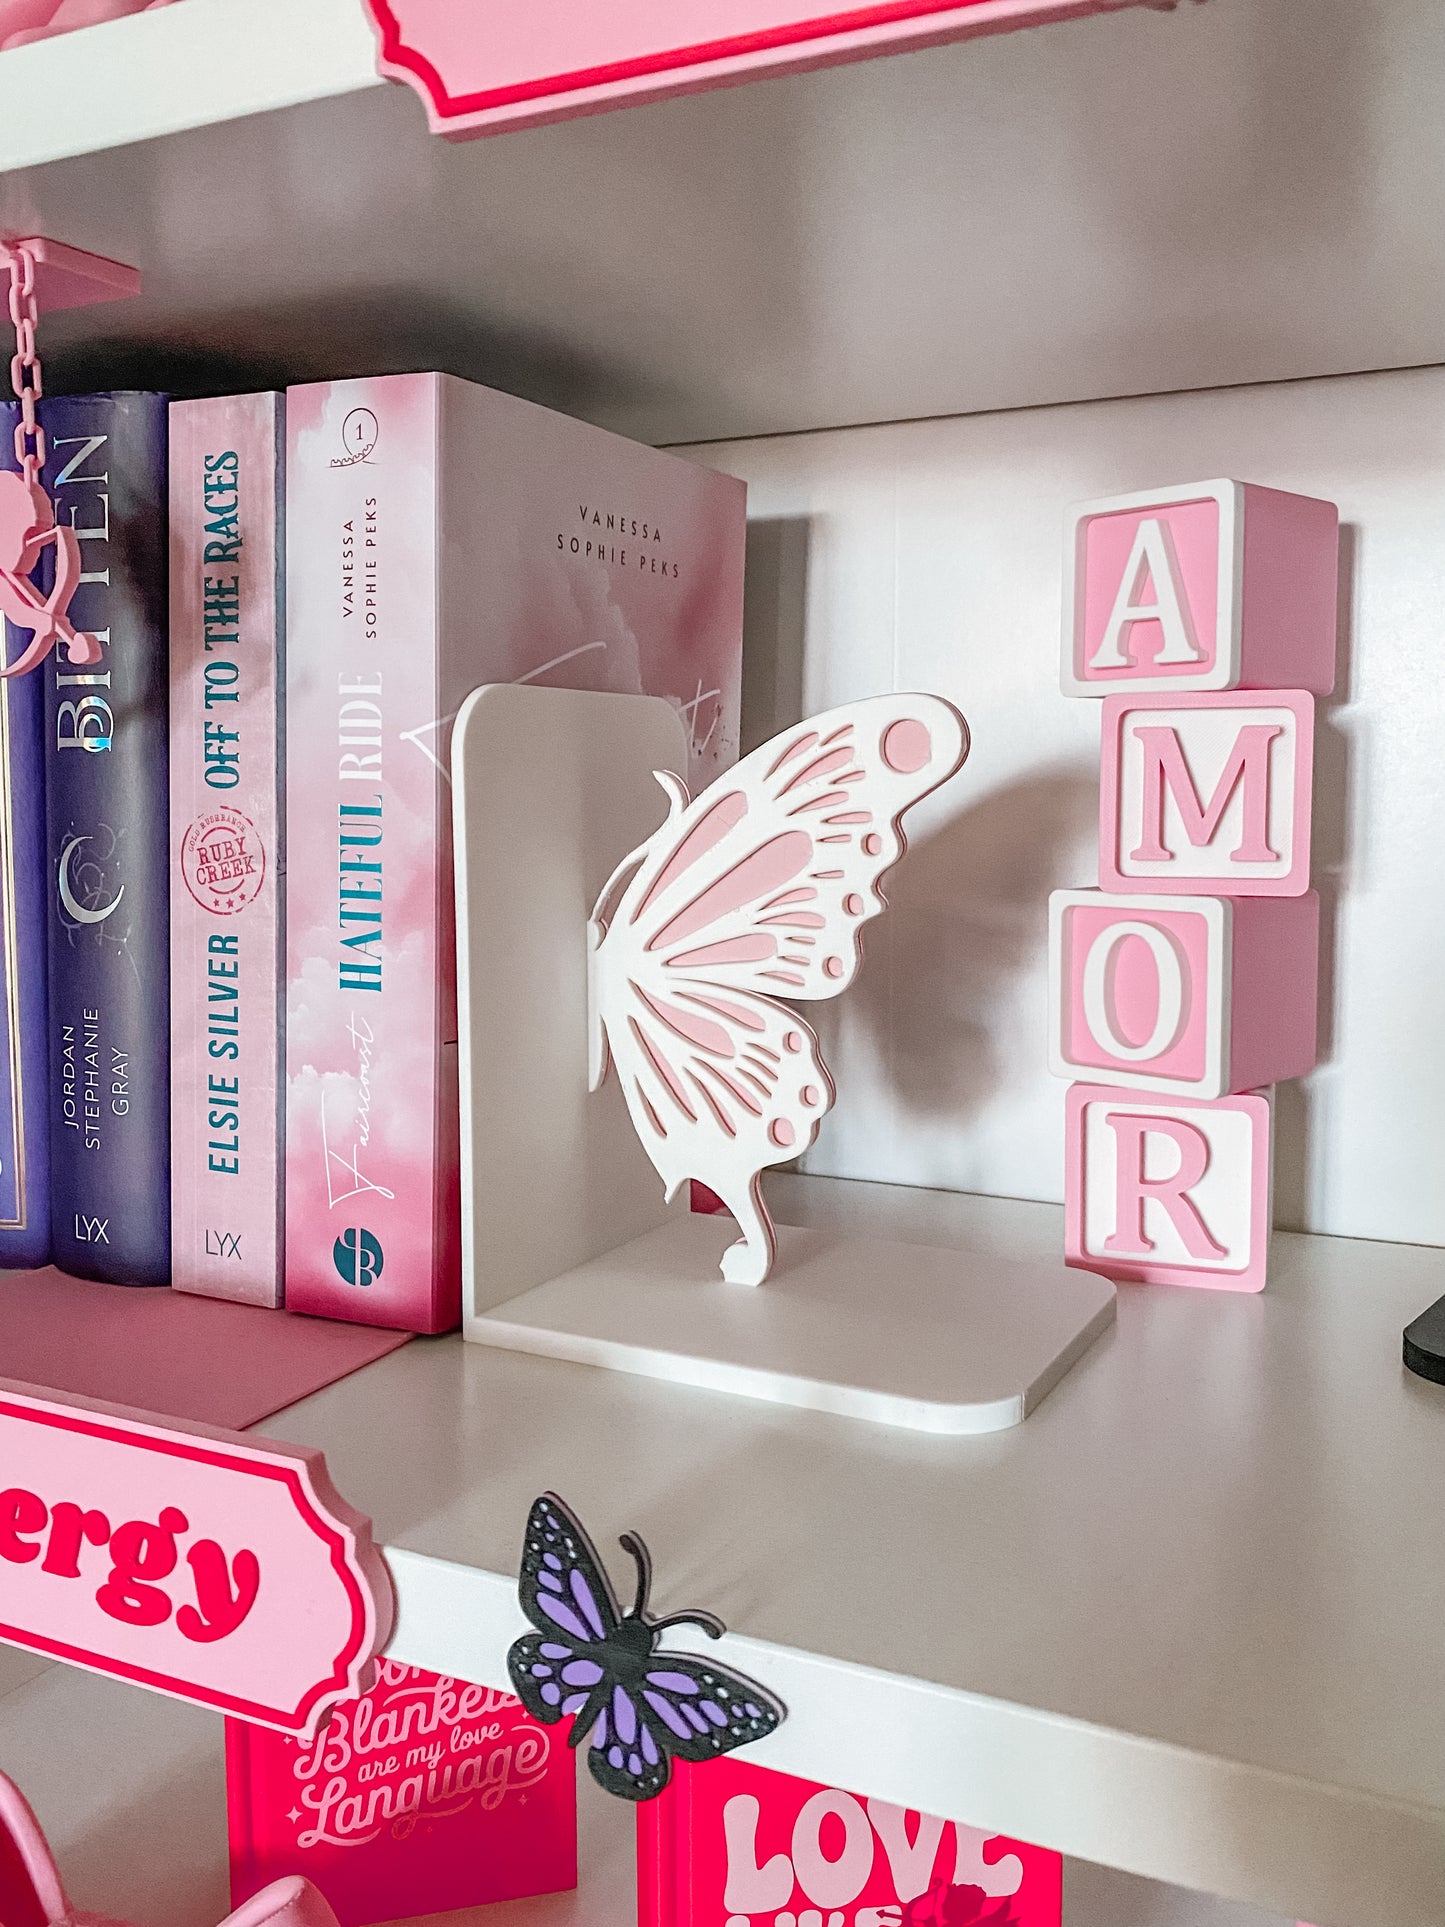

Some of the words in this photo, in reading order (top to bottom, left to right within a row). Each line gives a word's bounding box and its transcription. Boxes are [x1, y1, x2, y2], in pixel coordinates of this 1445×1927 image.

[203, 450, 244, 565] RACES
[365, 497, 377, 547] PEKS
[579, 505, 661, 543] VANESSA
[342, 519, 354, 618] VANESSA
[557, 533, 626, 566] SOPHIE
[640, 555, 679, 578] PEKS
[203, 575, 240, 651] THE
[365, 560, 377, 639] SOPHIE
[203, 661, 240, 709] TO
[203, 721, 240, 789] OFF
[338, 672, 383, 782] RIDE
[196, 836, 247, 866] RUBY
[196, 855, 256, 885] CREEK
[338, 794, 383, 993] HATEFUL
[208, 934, 239, 1060] SILVER
[62, 1025, 80, 1130] JORDAN
[83, 1008, 101, 1150] STEPHANIE
[111, 1047, 129, 1116] GRAY
[208, 1073, 239, 1175] ELSIE
[75, 1213, 110, 1244] LYX
[205, 1229, 242, 1260] LYX
[297, 1725, 550, 1849] Language
[357, 1756, 401, 1783] are
[405, 1741, 446, 1770] my
[450, 1722, 504, 1754] love
[723, 1789, 1023, 1914] LOVE
